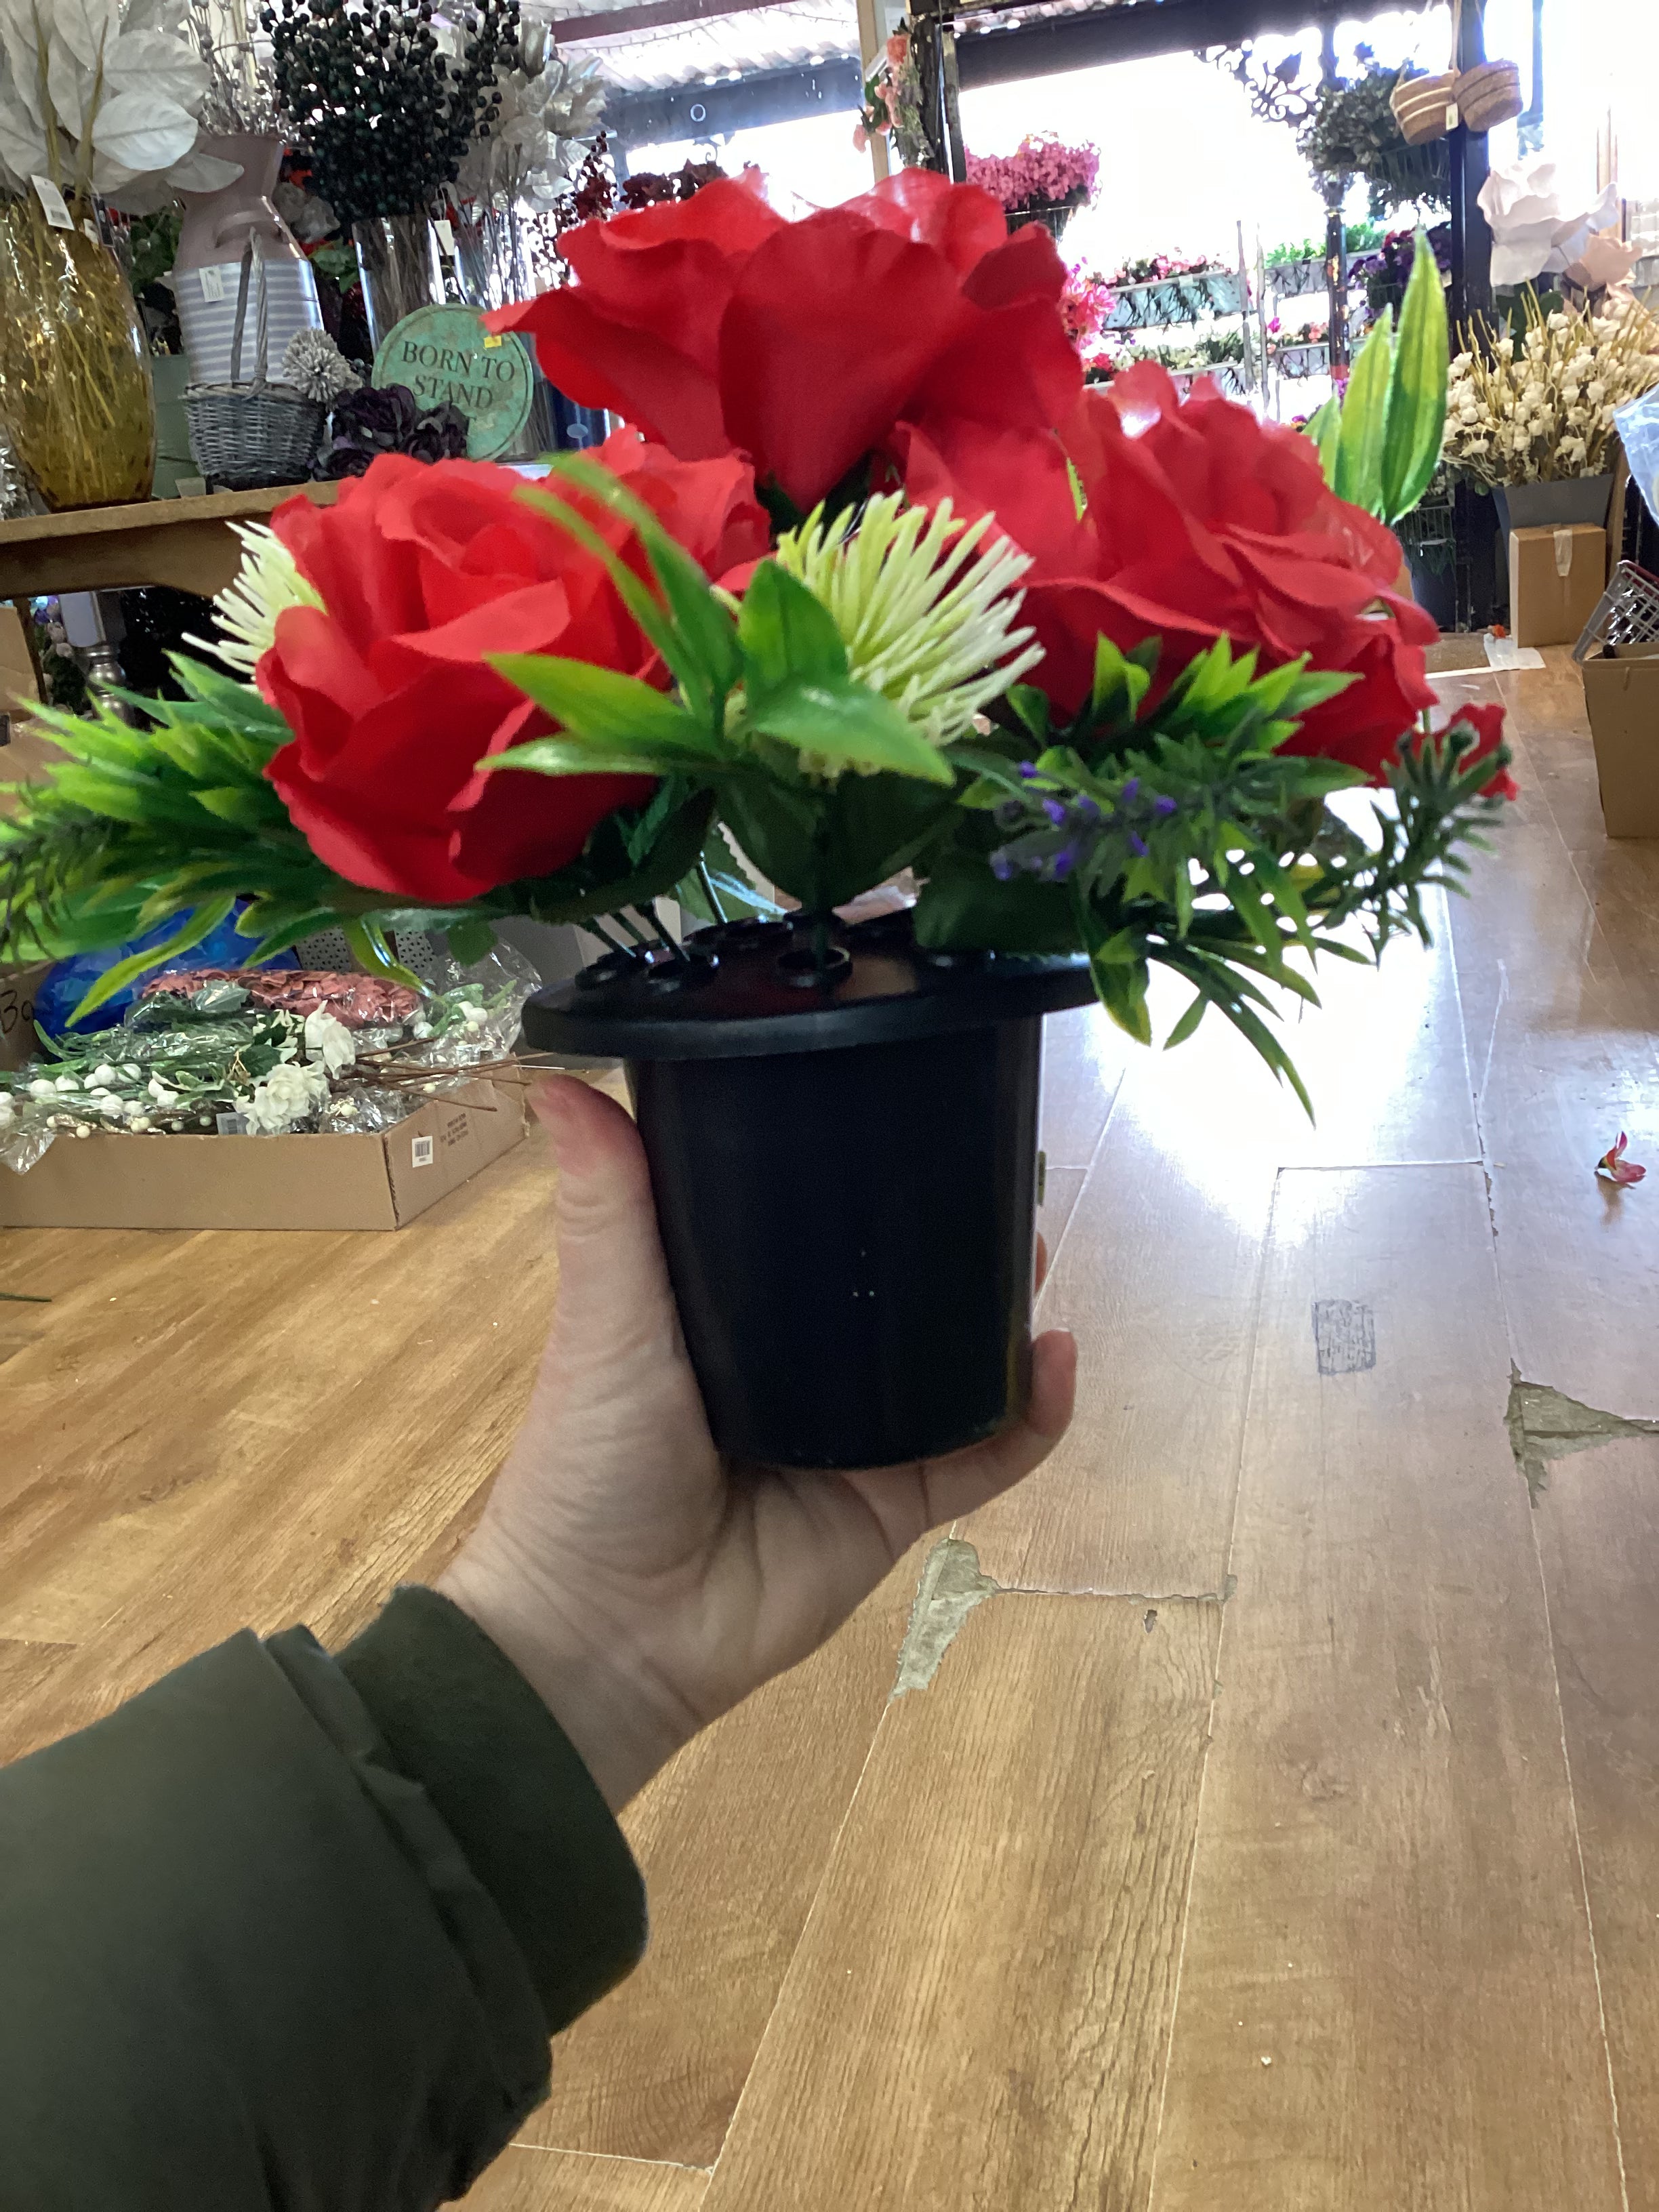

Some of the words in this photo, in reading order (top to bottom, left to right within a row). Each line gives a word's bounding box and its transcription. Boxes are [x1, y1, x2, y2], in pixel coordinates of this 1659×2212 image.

[402, 341, 476, 375] BORN
[481, 356, 515, 382] TO
[413, 375, 493, 409] STAND
